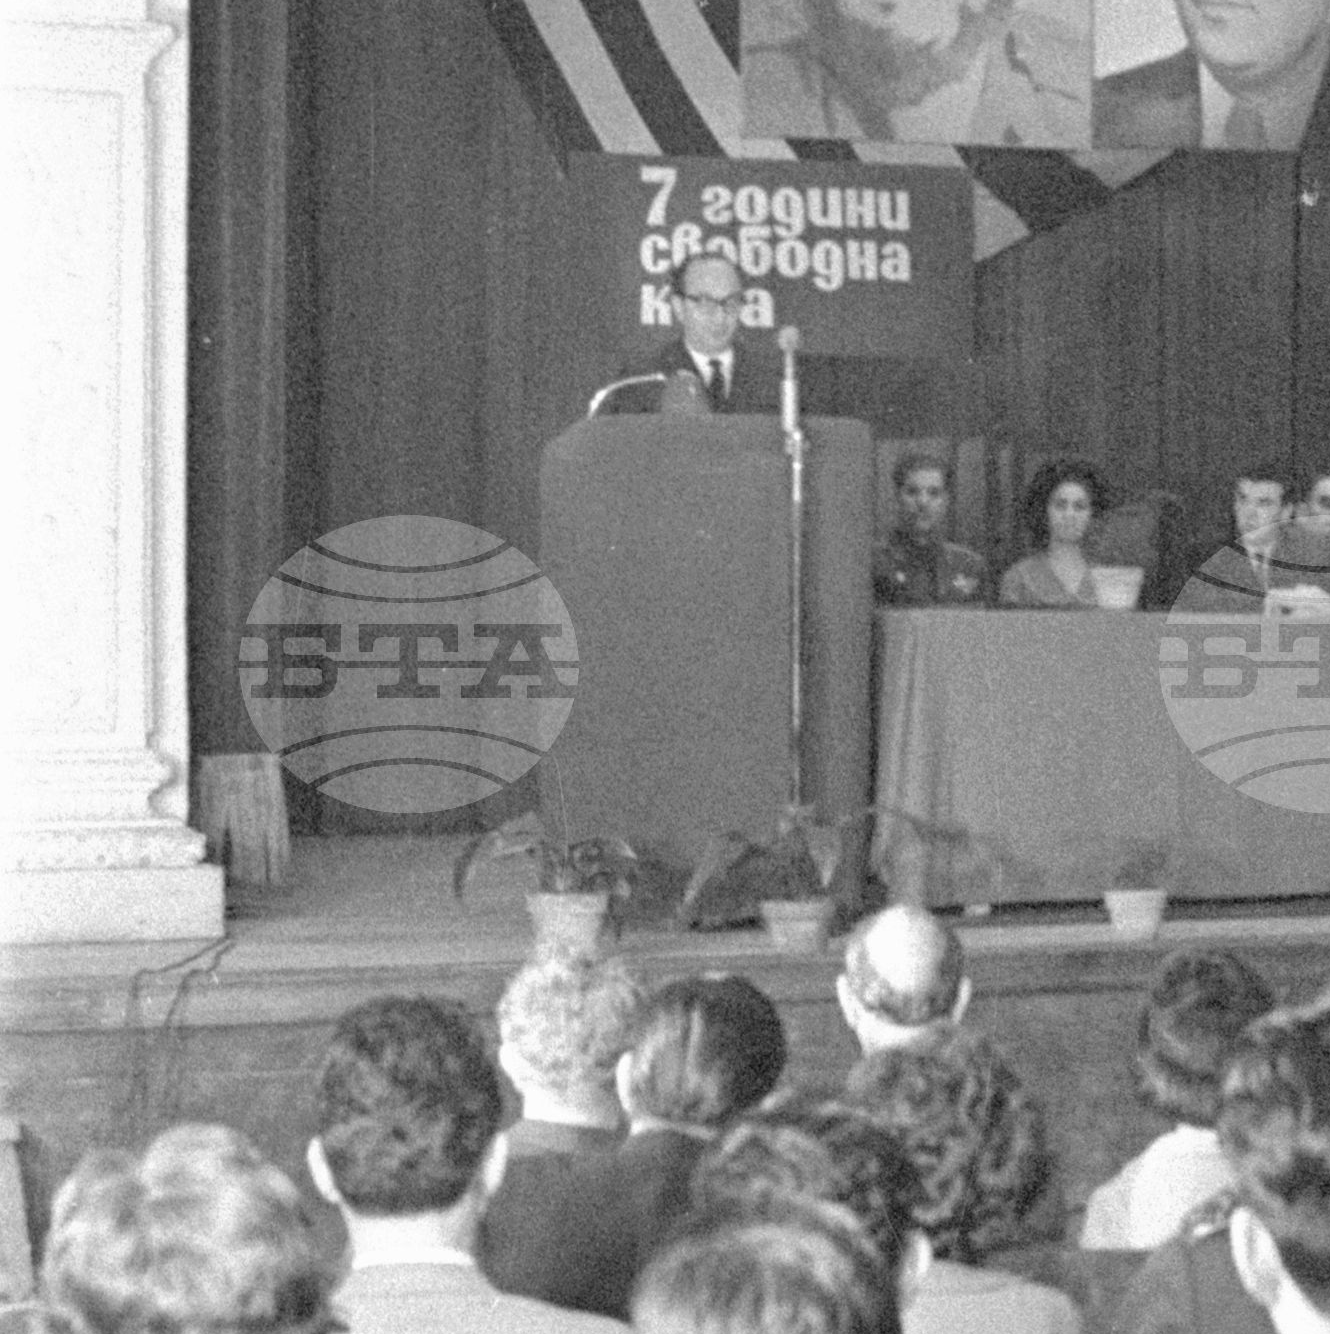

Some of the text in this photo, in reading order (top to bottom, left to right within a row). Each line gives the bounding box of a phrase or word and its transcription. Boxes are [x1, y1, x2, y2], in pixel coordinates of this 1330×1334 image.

[640, 166, 911, 237] 7 години
[639, 284, 775, 328] ка
